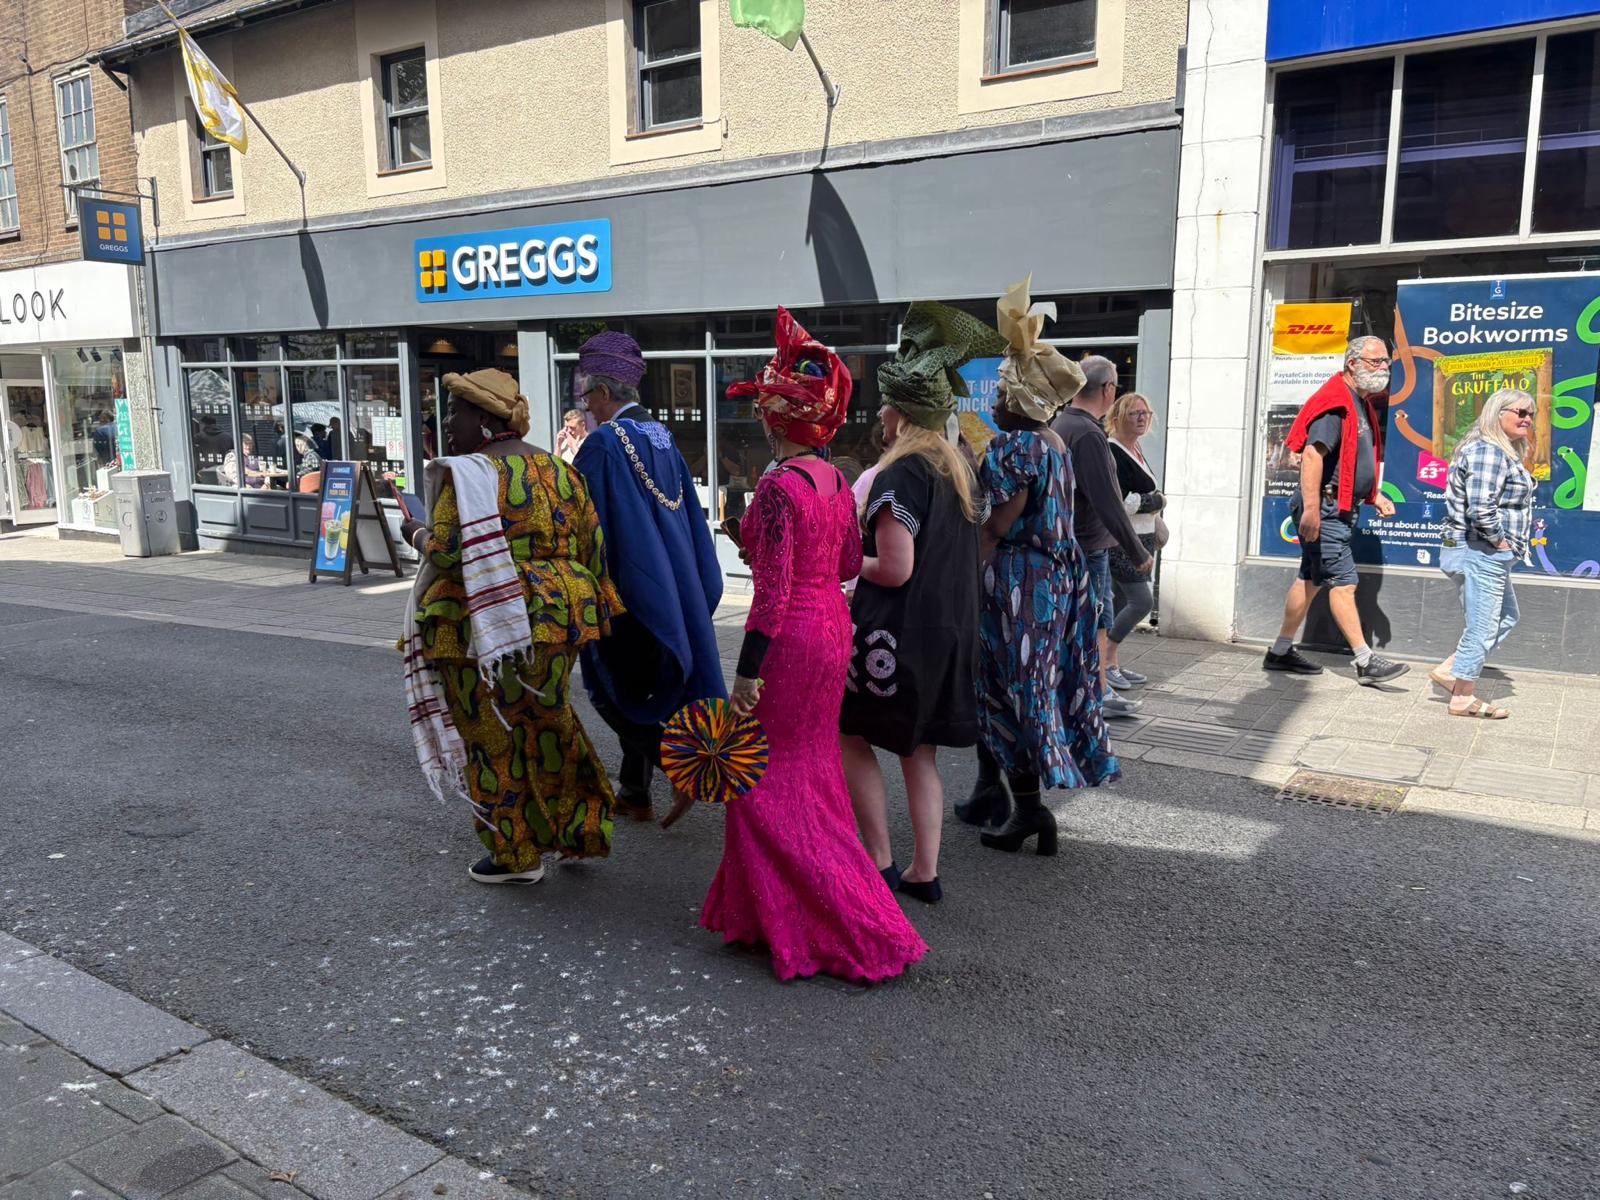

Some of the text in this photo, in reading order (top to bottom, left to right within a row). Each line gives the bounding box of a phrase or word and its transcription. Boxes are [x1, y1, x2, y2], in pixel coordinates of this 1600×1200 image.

[100, 243, 129, 253] GREGGS
[452, 234, 598, 286] GREGGS
[0, 288, 67, 323] LOOK
[1450, 301, 1543, 322] Bitesize
[1287, 324, 1336, 335] DHL
[1423, 325, 1568, 345] Bookworms
[1472, 372, 1485, 381] THE
[980, 380, 997, 395] UP
[1368, 519, 1382, 527] Tell
[1395, 521, 1419, 529] about
[1372, 528, 1387, 536] win
